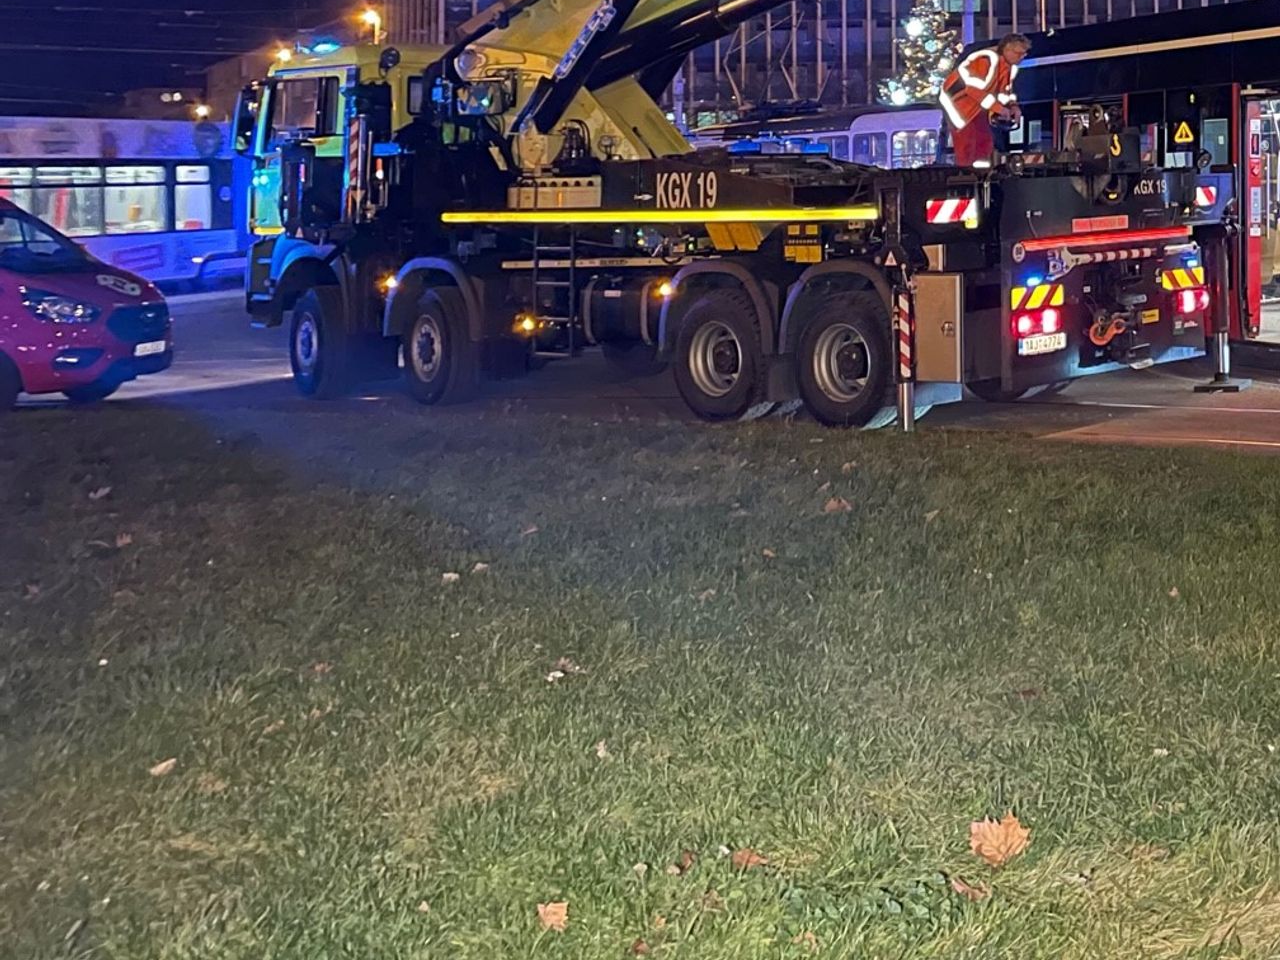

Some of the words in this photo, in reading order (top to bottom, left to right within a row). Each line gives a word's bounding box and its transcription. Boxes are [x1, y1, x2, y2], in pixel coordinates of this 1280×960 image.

[656, 172, 692, 209] KGX
[697, 171, 717, 208] 19
[1156, 179, 1168, 194] 19
